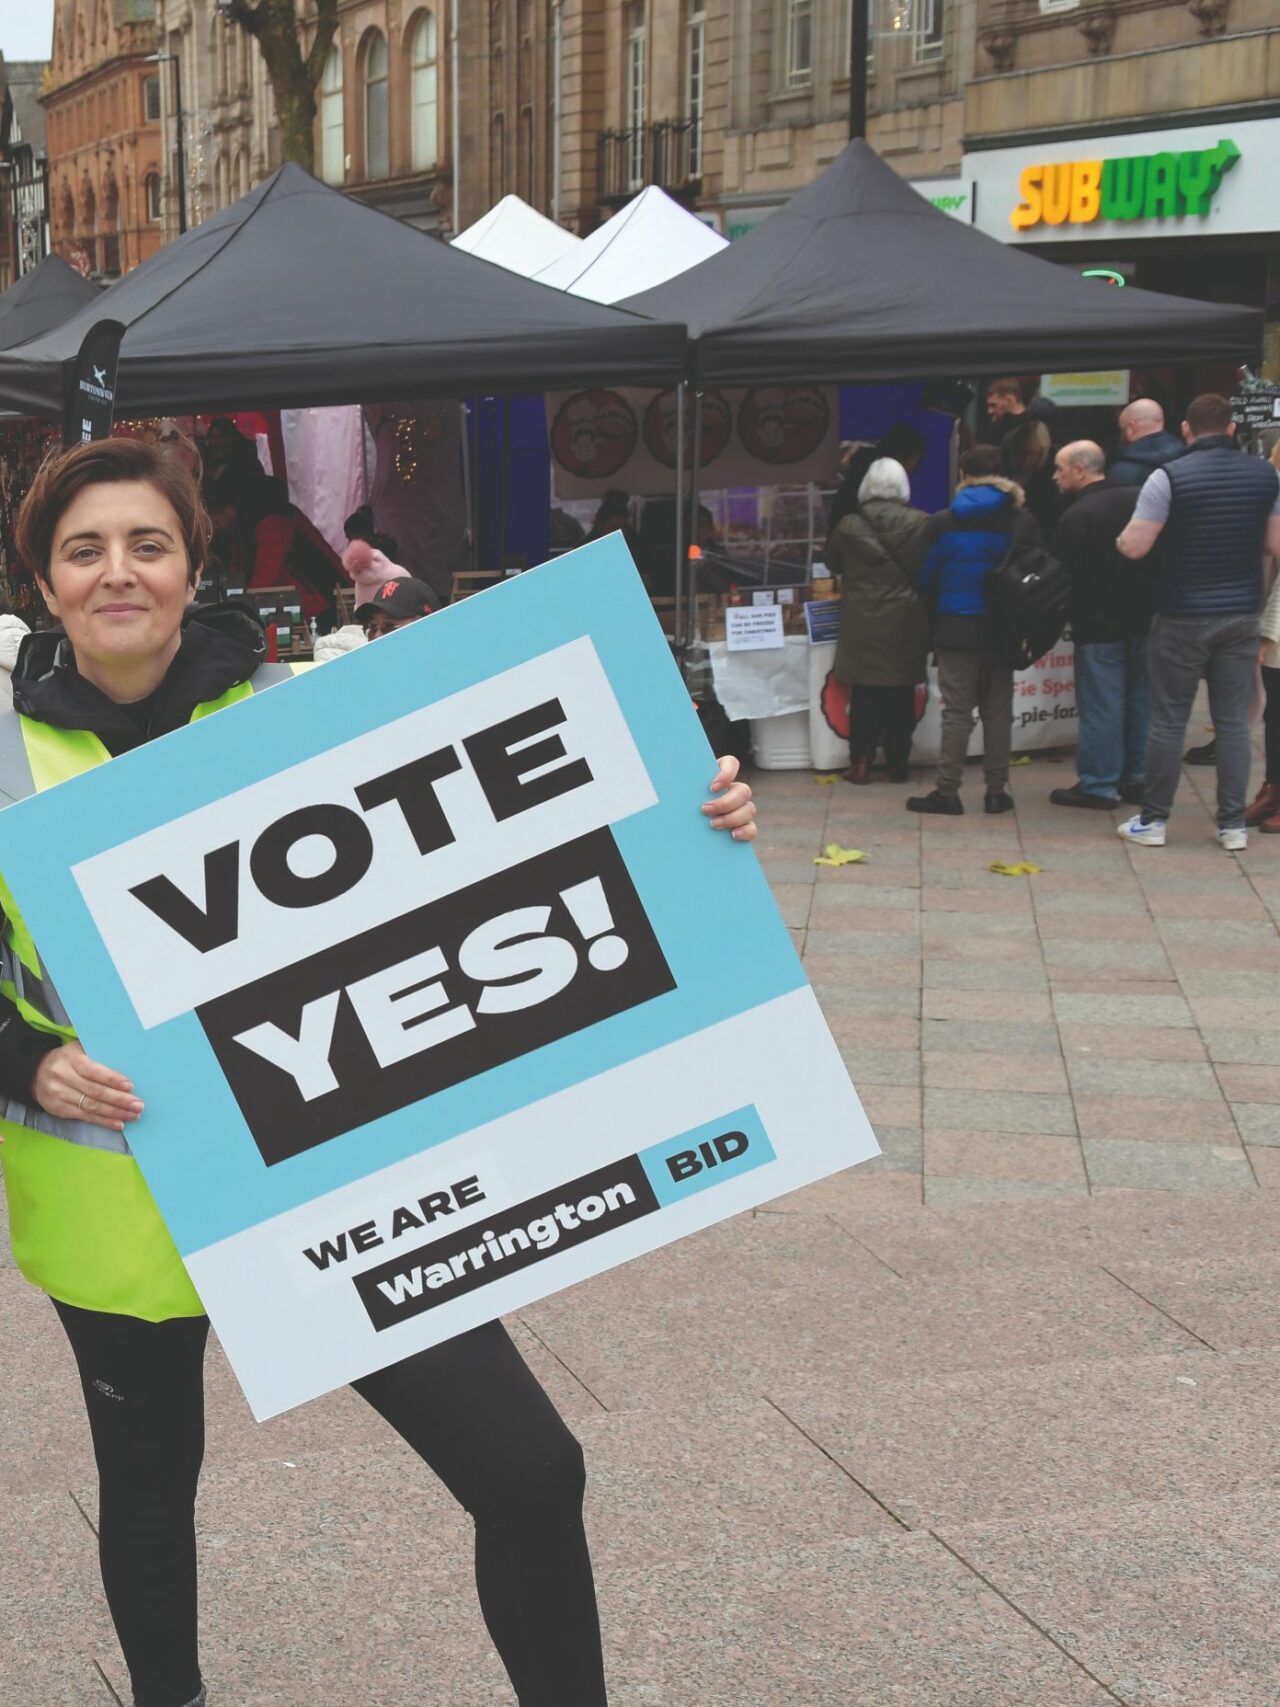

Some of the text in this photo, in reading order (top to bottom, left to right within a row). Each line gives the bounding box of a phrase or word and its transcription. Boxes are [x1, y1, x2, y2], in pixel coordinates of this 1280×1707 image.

[1009, 139, 1241, 232] SUBWAY
[1042, 678, 1075, 697] Spe
[127, 696, 594, 954] VOTE
[231, 875, 629, 1102] YES!
[301, 1174, 487, 1272] WE ARE
[376, 1130, 749, 1306] Warrington BID
